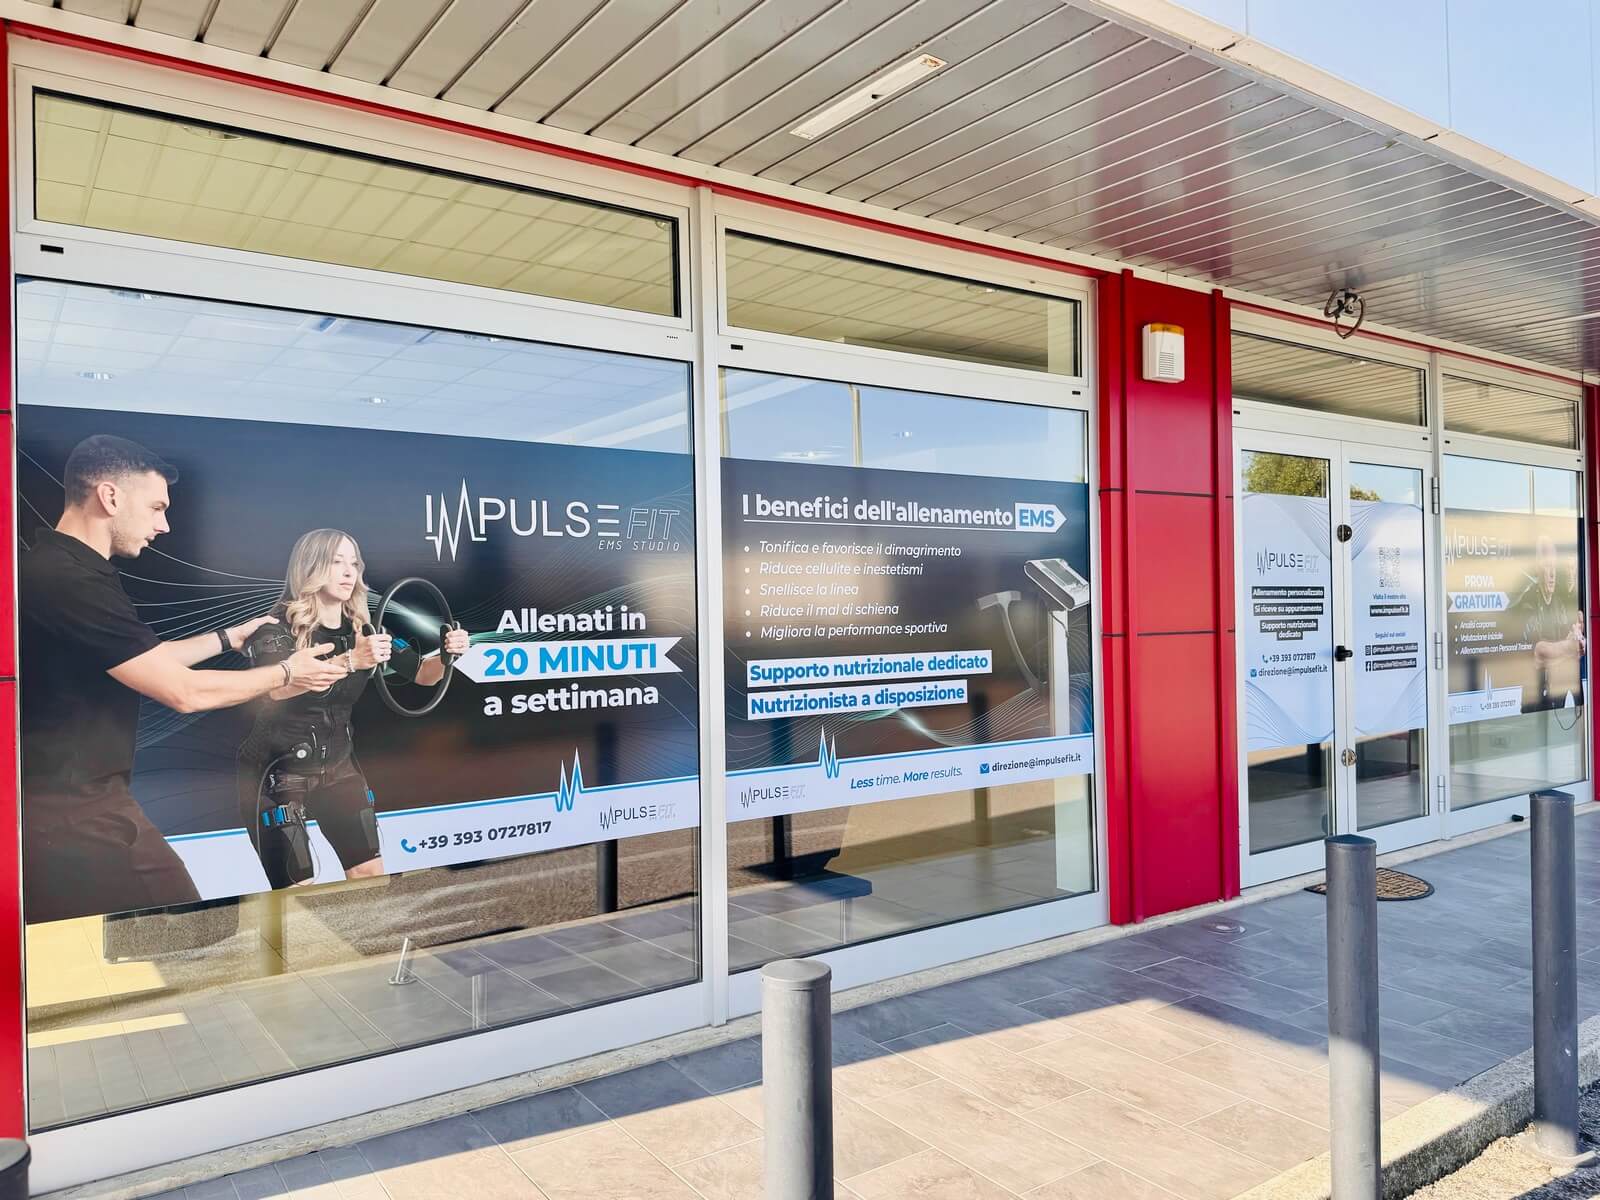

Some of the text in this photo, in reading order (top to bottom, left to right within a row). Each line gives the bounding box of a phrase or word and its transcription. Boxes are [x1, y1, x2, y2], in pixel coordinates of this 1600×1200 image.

[425, 478, 681, 562] IMPULSE FIT
[742, 494, 1056, 528] I benefici dell'allenamento EMS
[598, 539, 681, 552] EMS STUDIO
[759, 541, 961, 558] Tonifica e favorisce il dimagrimento
[759, 563, 924, 577] Riduce cellulite e inestetismi
[759, 583, 859, 596] Snellisce la linea
[1464, 575, 1495, 588] PROVA
[760, 603, 899, 618] Riduce il mal di schiena
[1455, 594, 1503, 609] GRATUITA
[496, 605, 646, 634] Allenati in
[760, 621, 948, 642] Migliora la performance sportiva
[483, 643, 657, 677] 20 MINUTI
[750, 655, 989, 685] Supporto nutrizionale dedicato
[484, 683, 659, 717] a settimana
[751, 686, 965, 714] Nutrizionista a disposizione
[992, 752, 1082, 773] direzione@impulsefit.it
[850, 766, 963, 790] Less time. More results.
[418, 820, 552, 850] +39 393 0727817
